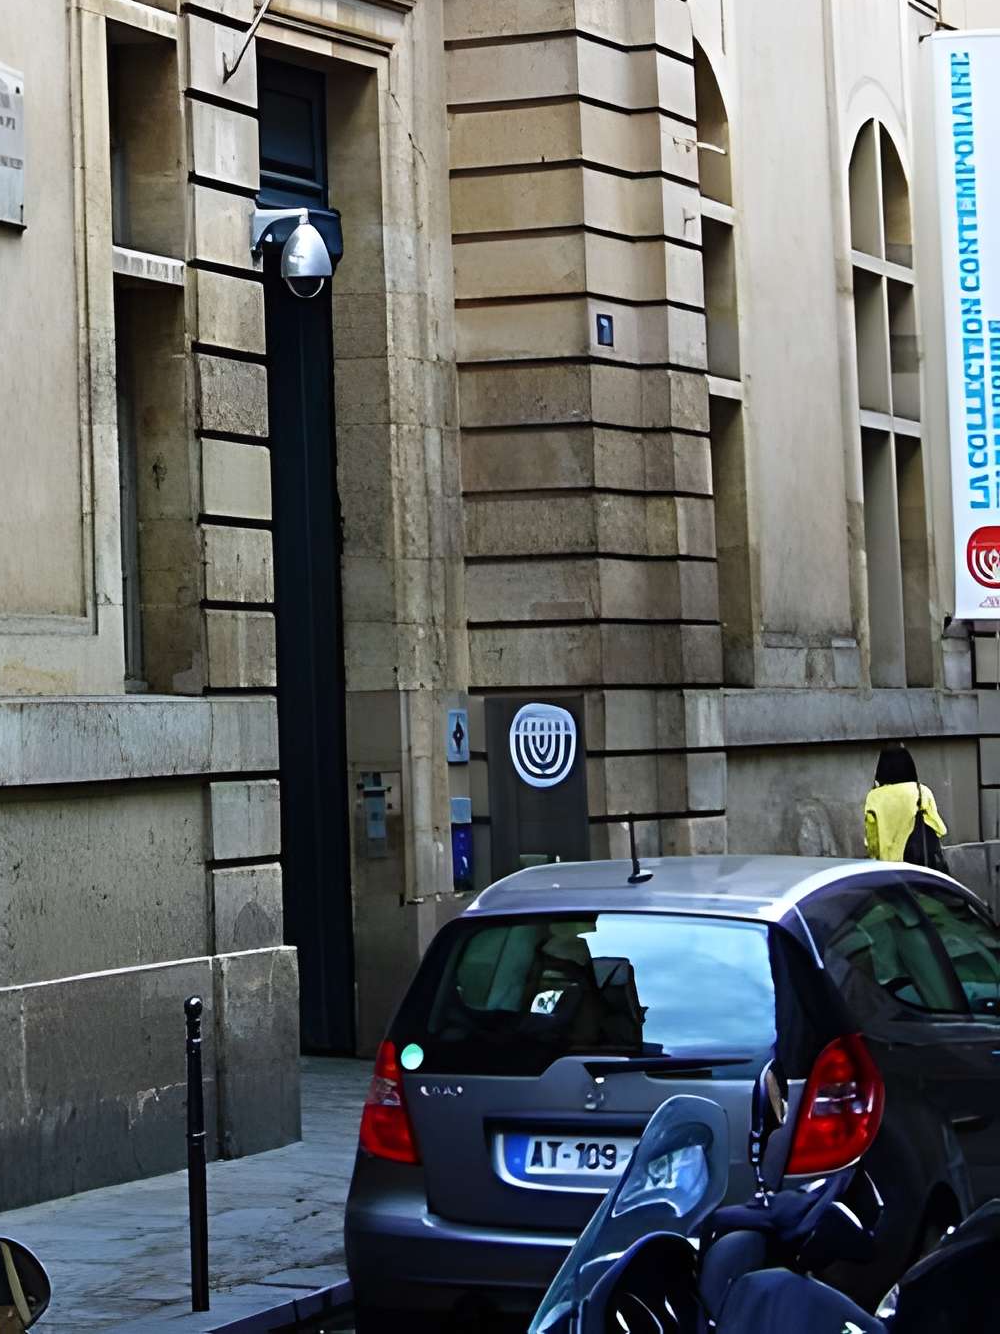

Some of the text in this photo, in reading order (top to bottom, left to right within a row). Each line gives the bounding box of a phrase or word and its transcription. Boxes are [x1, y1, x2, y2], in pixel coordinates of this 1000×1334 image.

[950, 52, 990, 509] LA COLLECTION CONTEMPORAINE
